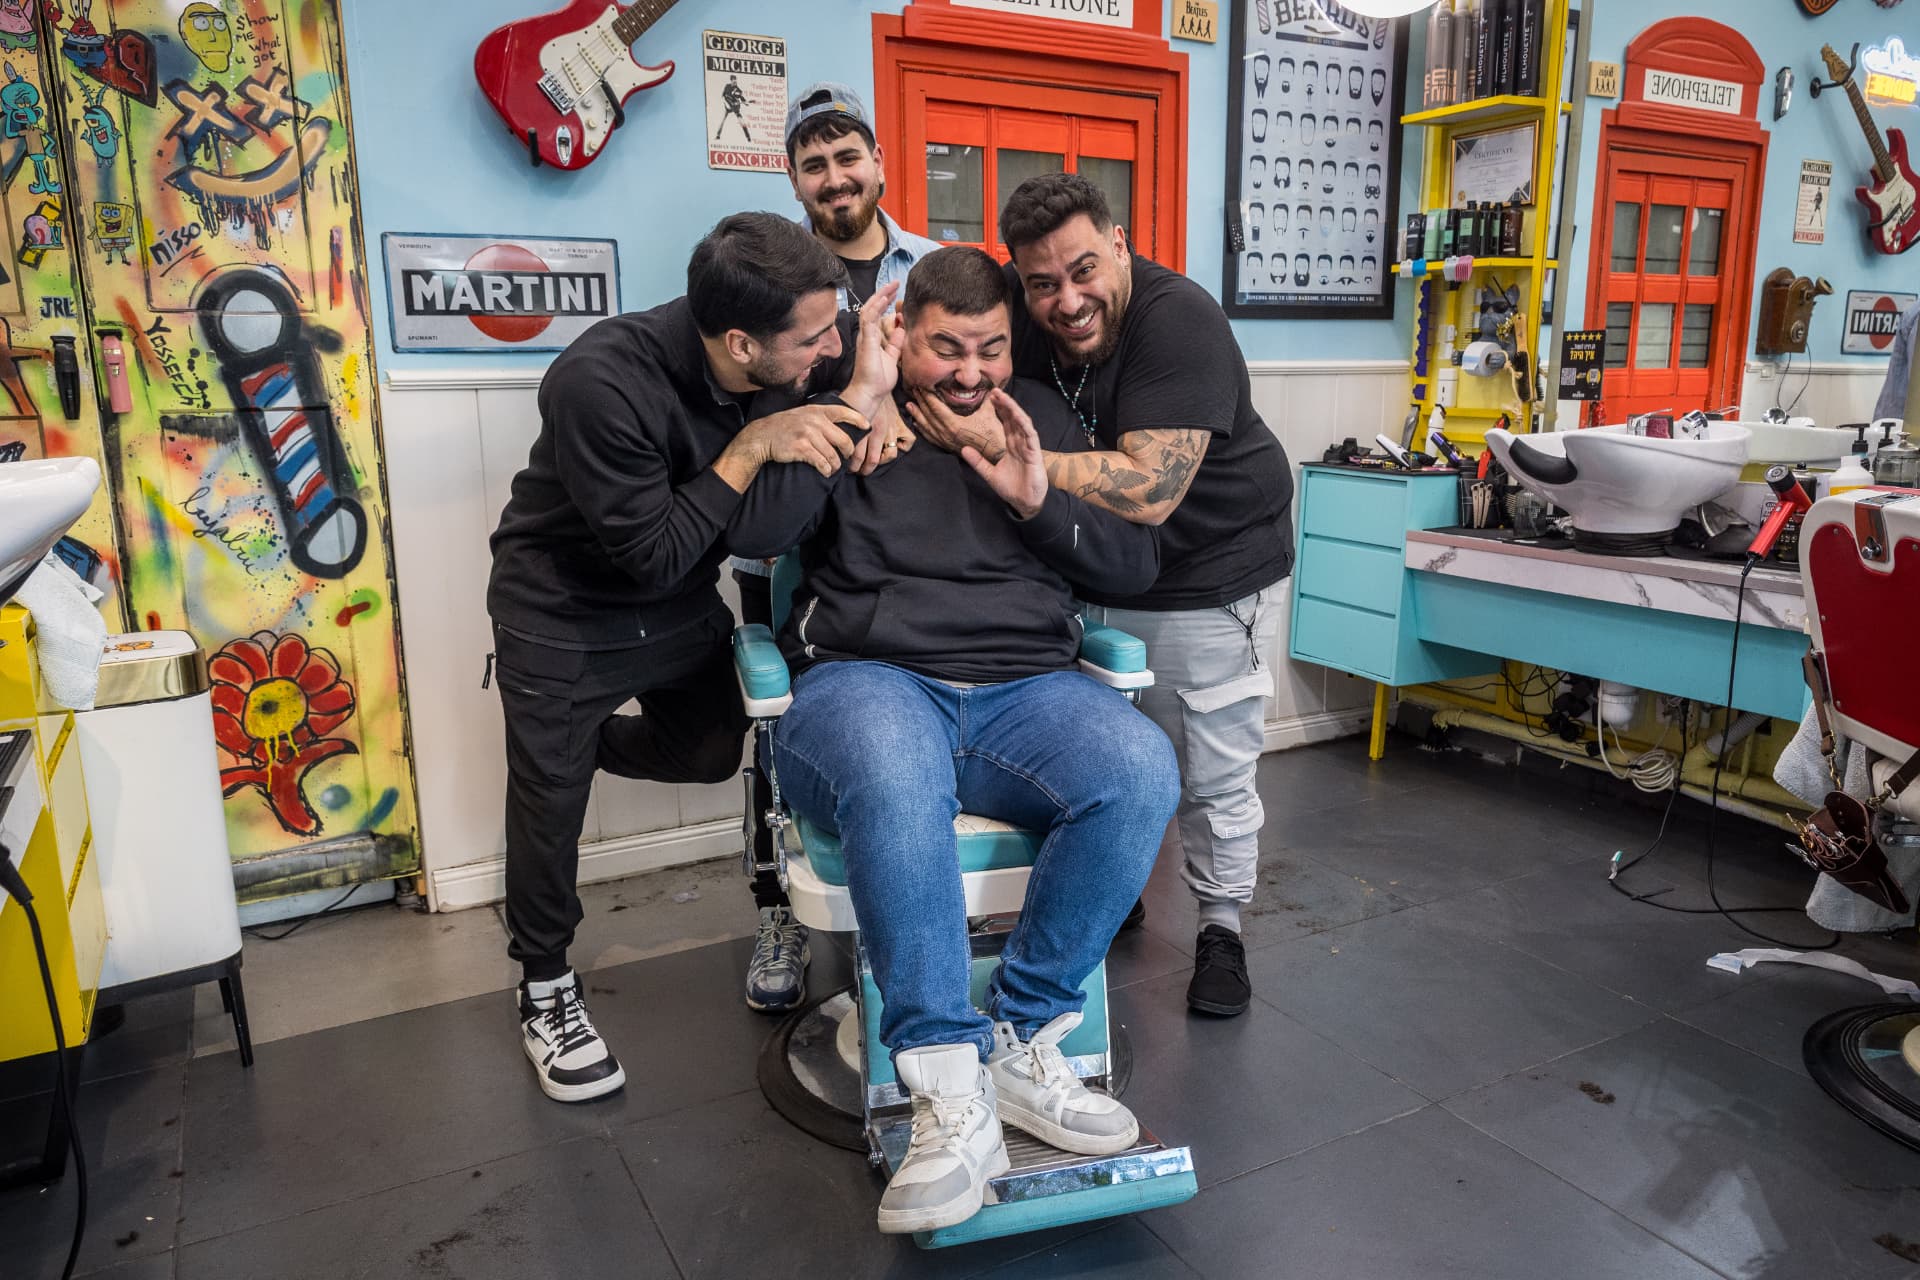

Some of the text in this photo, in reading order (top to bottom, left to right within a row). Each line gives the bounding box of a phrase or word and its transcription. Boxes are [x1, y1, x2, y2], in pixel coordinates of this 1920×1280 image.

[708, 35, 783, 56] GEORGE
[1477, 33, 1485, 85] SILHOUETTE
[1501, 32, 1510, 83] SILHOUETTE
[1521, 26, 1530, 79] SILHOUETTE
[712, 57, 781, 75] MICHAEL
[714, 151, 787, 168] CONCERT
[40, 296, 76, 319] JRL
[410, 274, 602, 313] MARTINI
